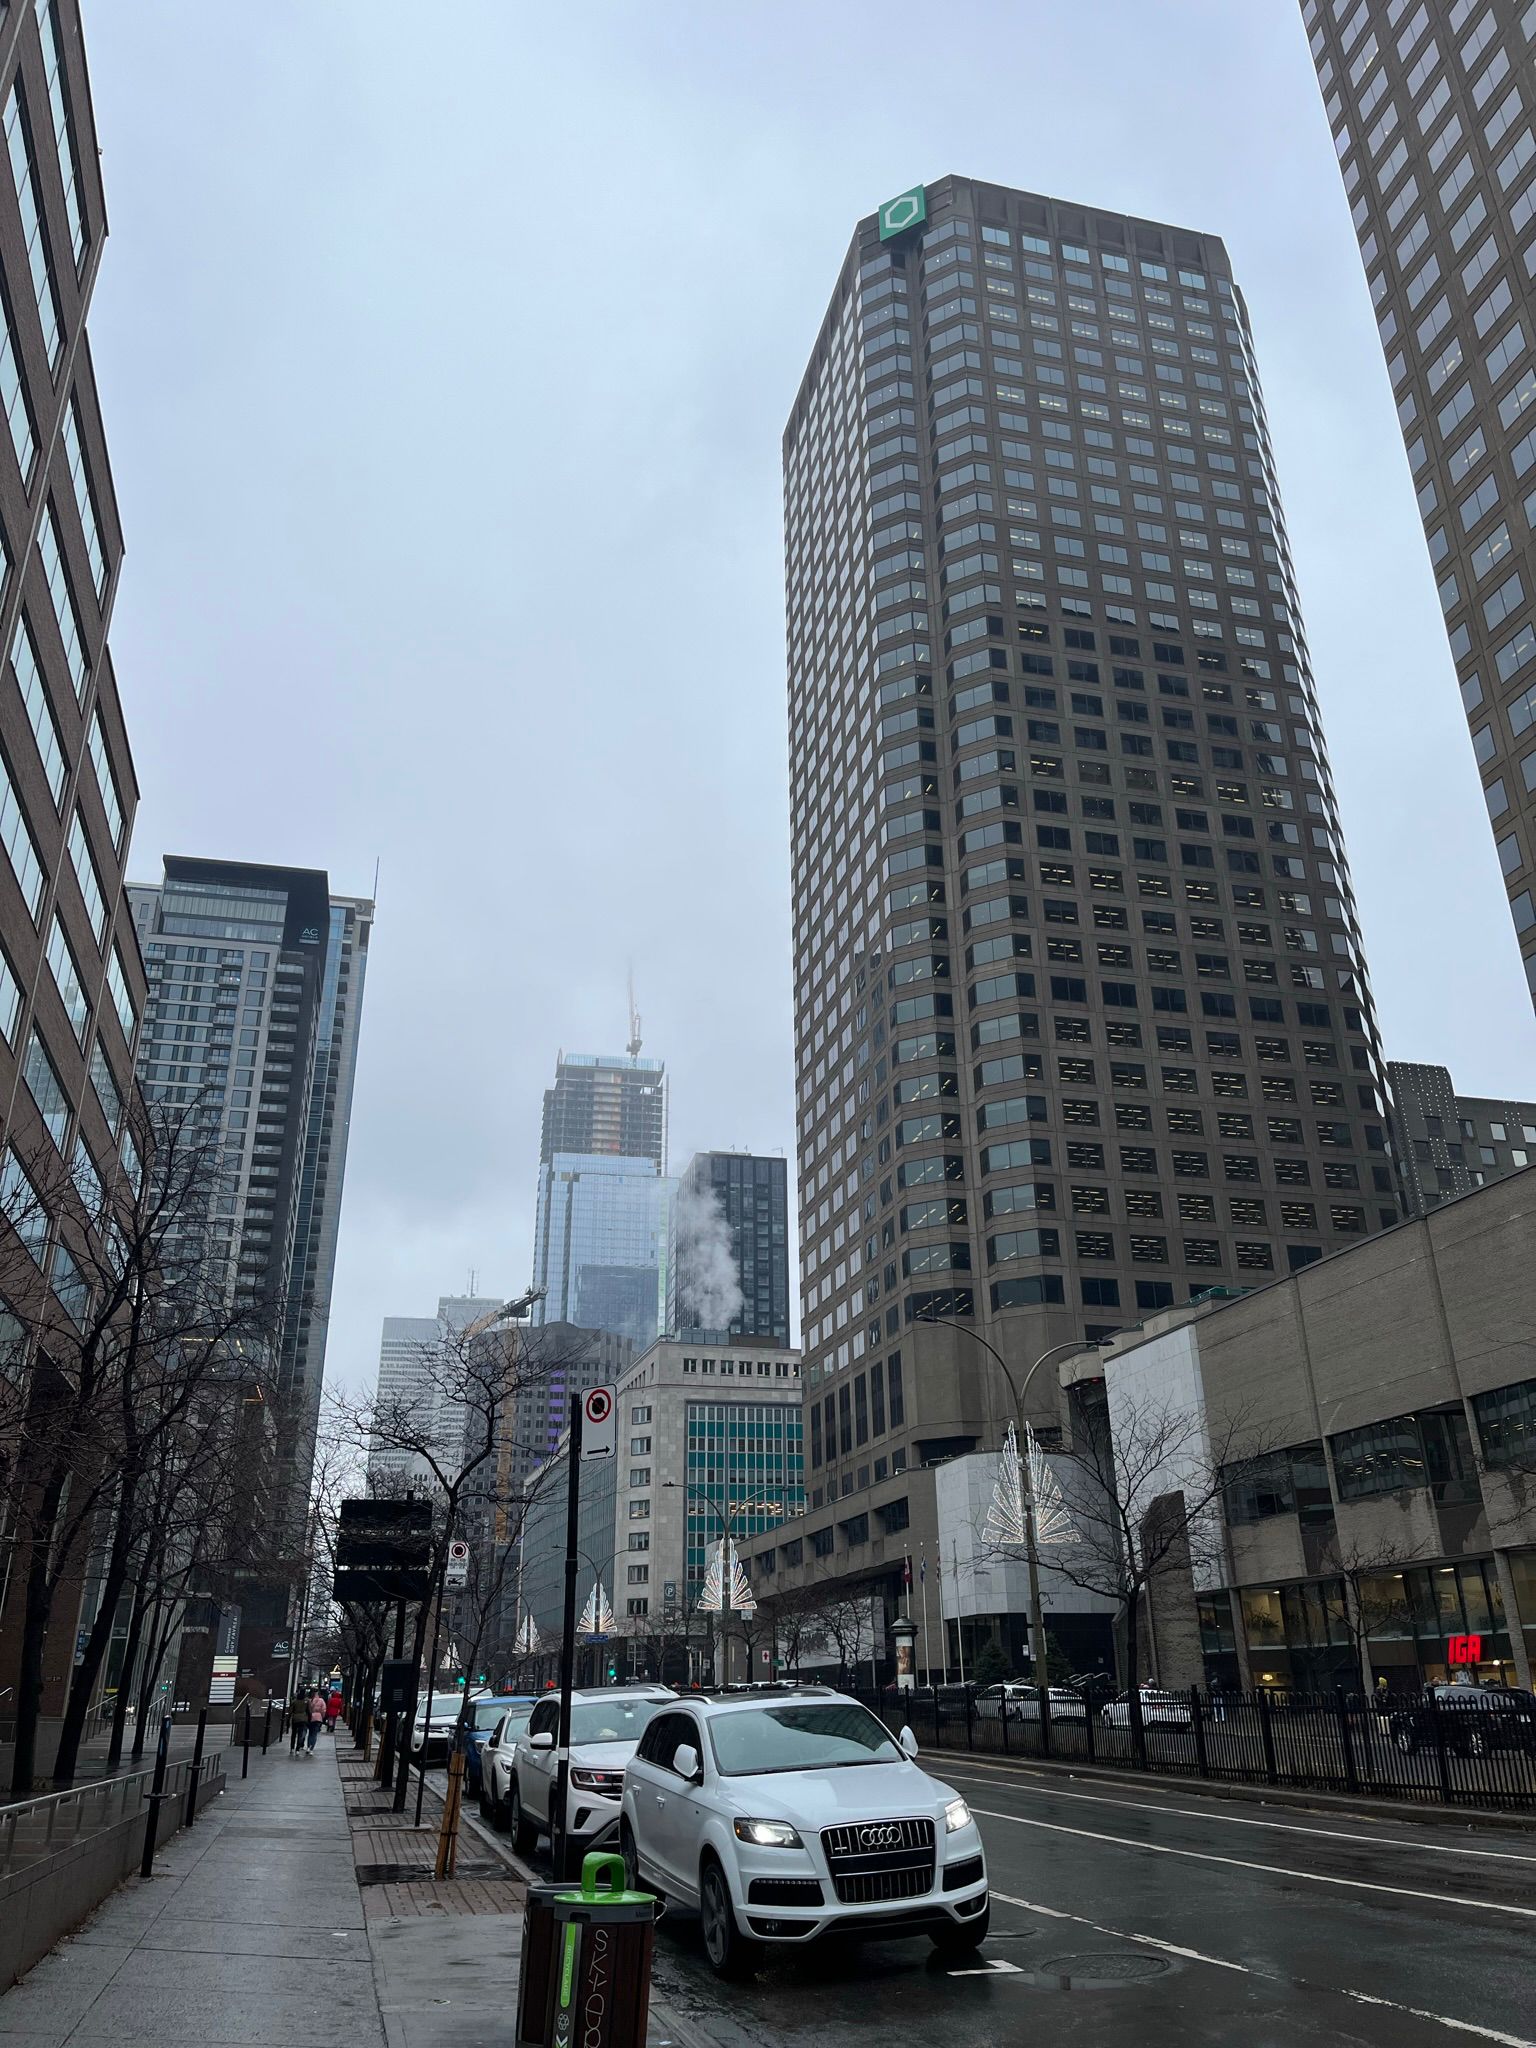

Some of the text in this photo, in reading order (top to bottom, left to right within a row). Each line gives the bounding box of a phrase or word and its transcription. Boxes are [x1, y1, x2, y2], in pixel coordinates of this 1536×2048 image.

[302, 927, 319, 936] AC
[274, 1640, 289, 1649] AC
[1448, 1634, 1481, 1665] IGA
